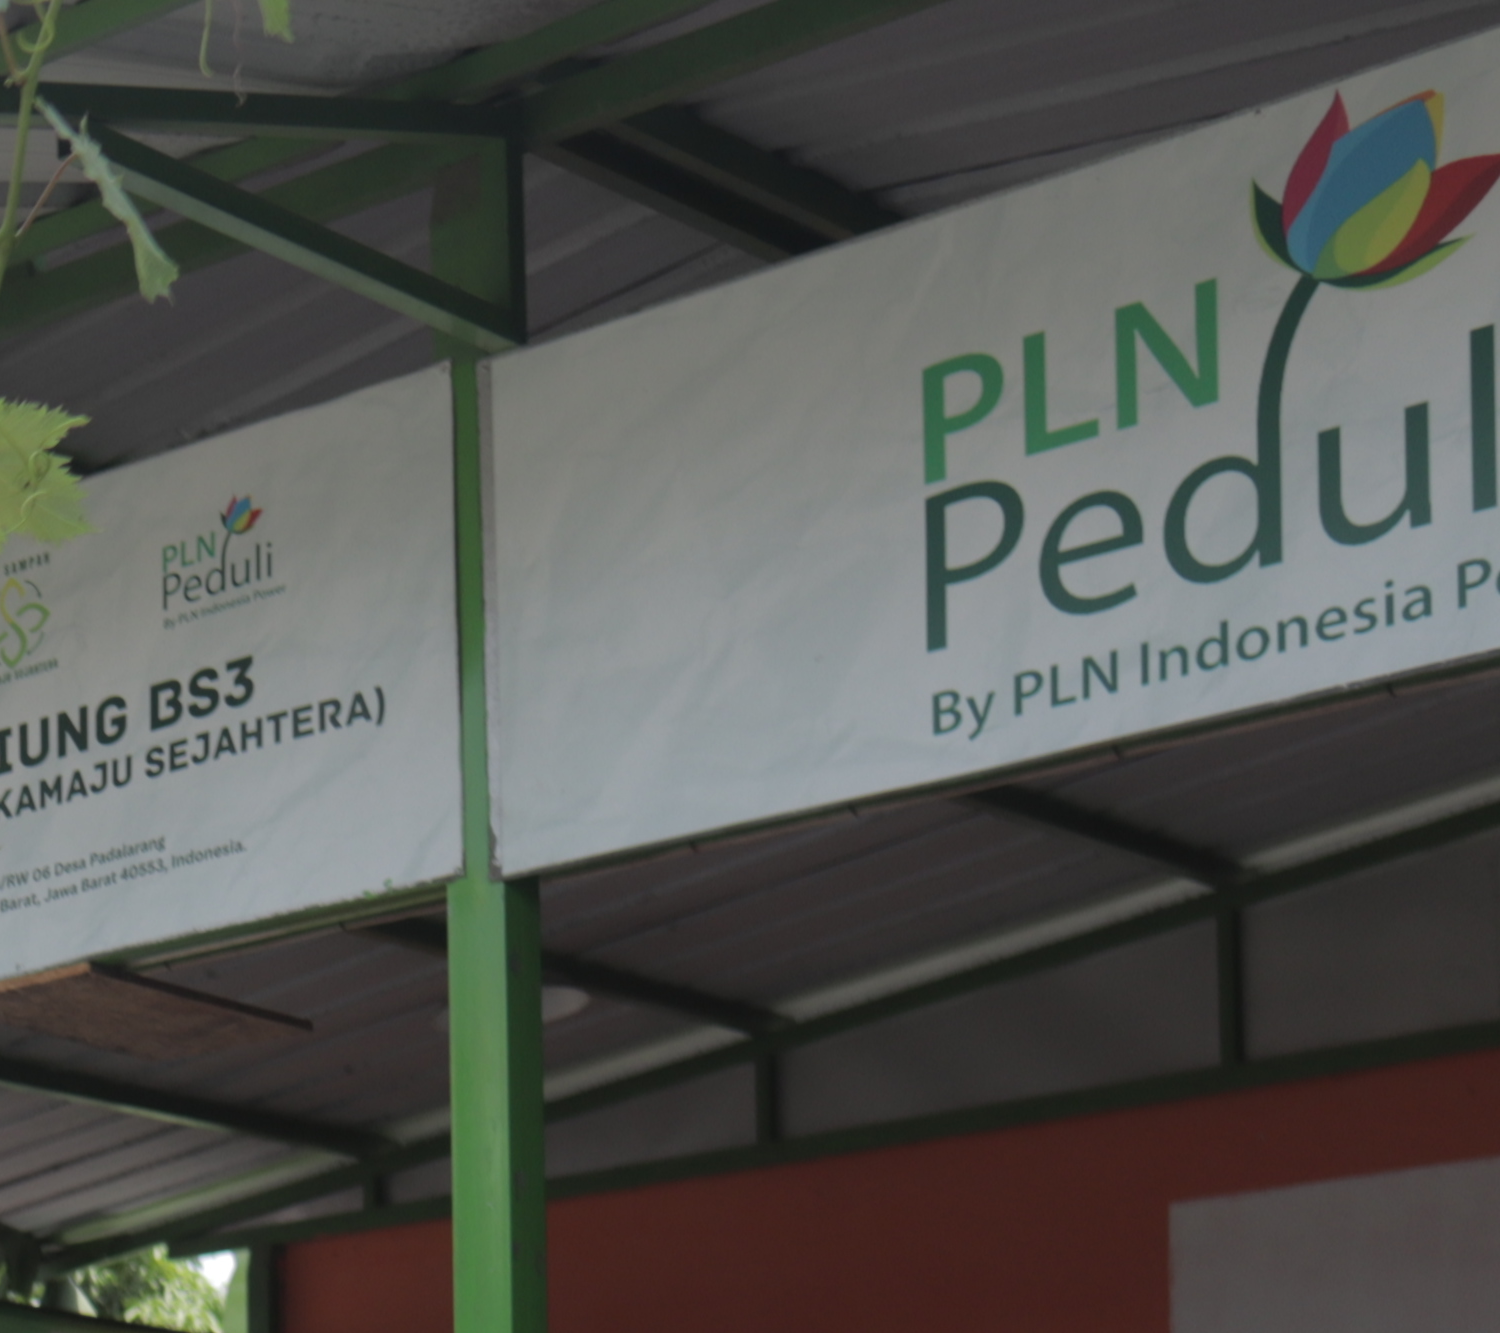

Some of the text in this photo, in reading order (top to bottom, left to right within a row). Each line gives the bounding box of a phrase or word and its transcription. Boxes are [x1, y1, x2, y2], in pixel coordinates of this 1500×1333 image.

[922, 278, 1220, 485] PLN
[924, 277, 1499, 653] Pedul
[162, 531, 217, 573] PLN
[162, 541, 273, 610] Peduli
[148, 655, 256, 732] BS3
[932, 690, 995, 741] By
[1012, 650, 1121, 715] PLN
[1140, 580, 1433, 686] Indonesia
[145, 685, 386, 780] SEJAHTERA)
[33, 865, 52, 882] 06
[54, 857, 87, 877] Desa
[89, 836, 167, 869] Padalarang
[44, 883, 80, 903] Jawa
[81, 872, 118, 894] Barat
[171, 839, 248, 870] Indonesia.
